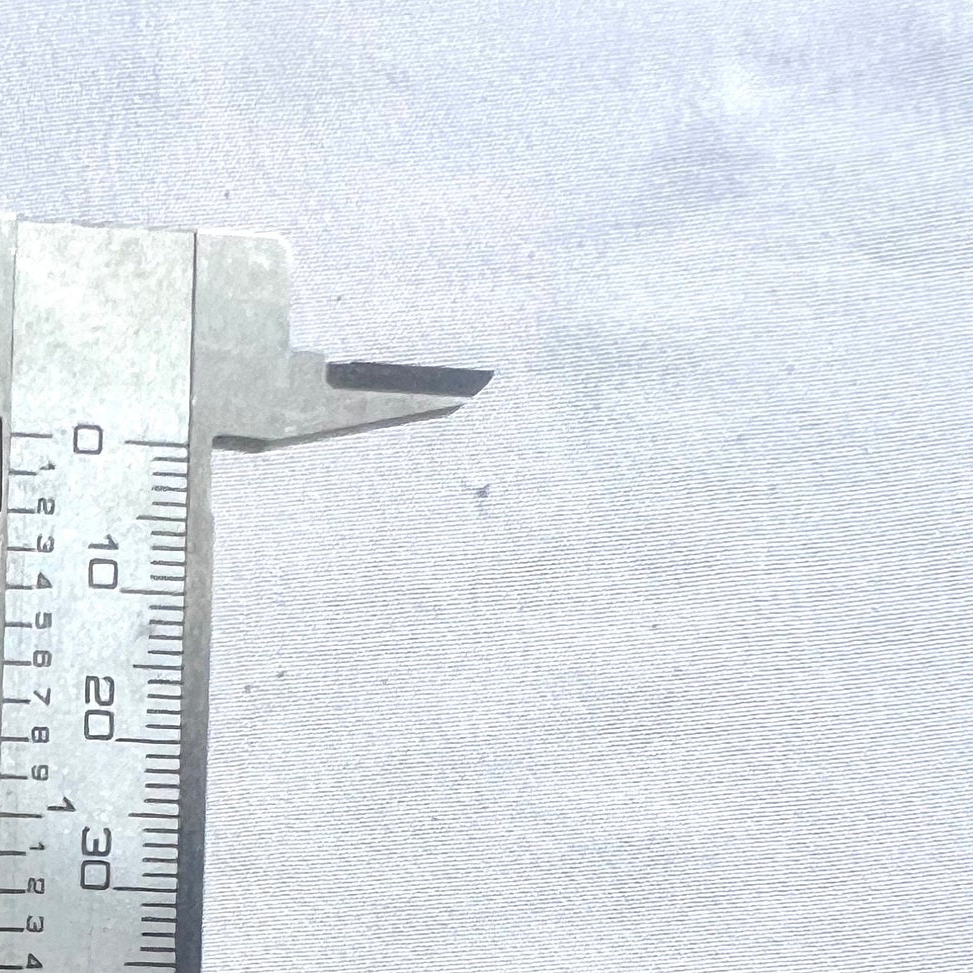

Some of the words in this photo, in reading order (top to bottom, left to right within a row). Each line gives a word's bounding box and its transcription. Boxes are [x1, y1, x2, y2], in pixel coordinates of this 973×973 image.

[73, 423, 104, 455] 0
[36, 497, 56, 516] 2
[36, 534, 55, 553] 3
[87, 533, 119, 590] 10
[35, 571, 53, 590] 4
[34, 611, 53, 630] 5
[32, 649, 53, 668] 6
[33, 687, 52, 706] 7
[83, 675, 115, 741] 20
[30, 725, 50, 744] 8
[31, 764, 49, 782] 9
[46, 796, 76, 812] 1
[80, 825, 112, 891] 30
[27, 877, 45, 895] 2
[26, 915, 45, 933] 3
[26, 952, 44, 969] 4
